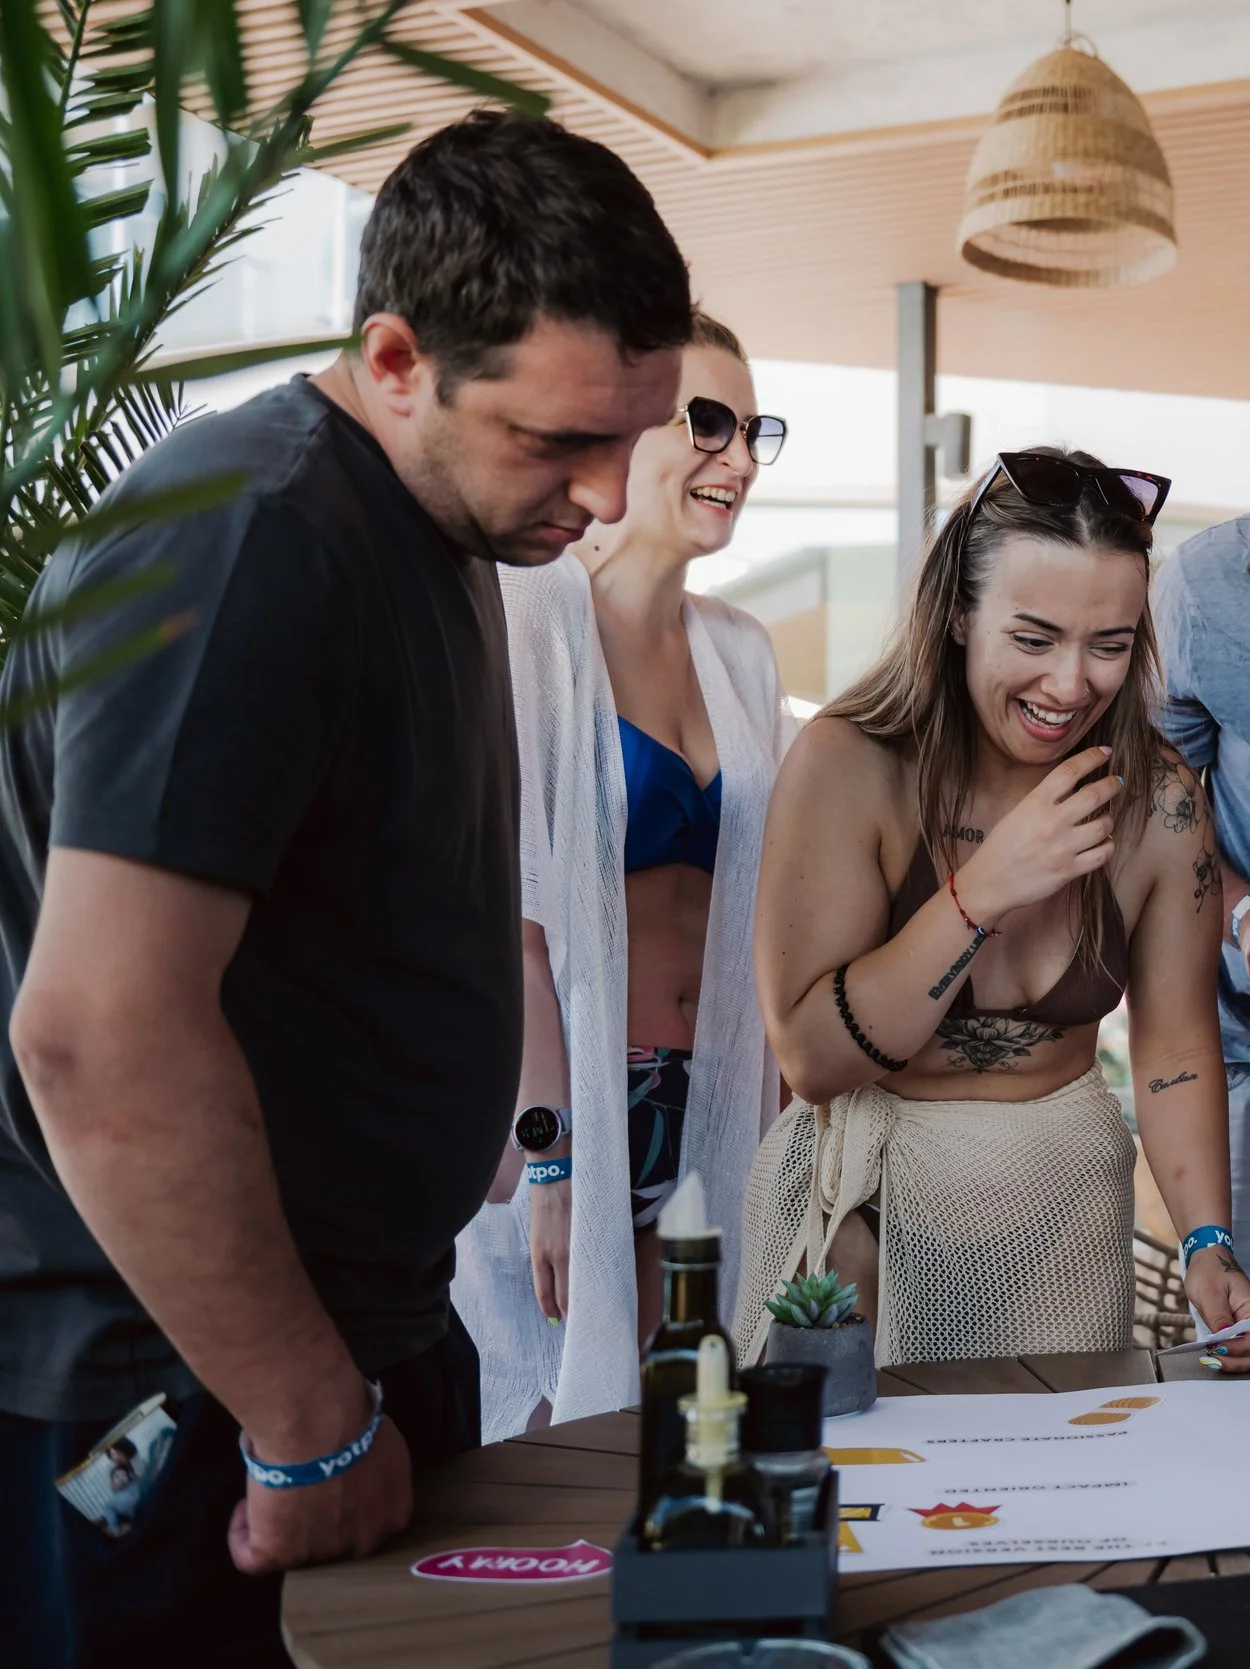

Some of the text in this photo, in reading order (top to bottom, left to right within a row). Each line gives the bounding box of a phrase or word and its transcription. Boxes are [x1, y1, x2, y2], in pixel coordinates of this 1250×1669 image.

[1021, 1431, 1128, 1441] PASSIONATE
[944, 1482, 1129, 1494] IMPACT ORIENTED
[436, 1555, 600, 1572] HOORAY
